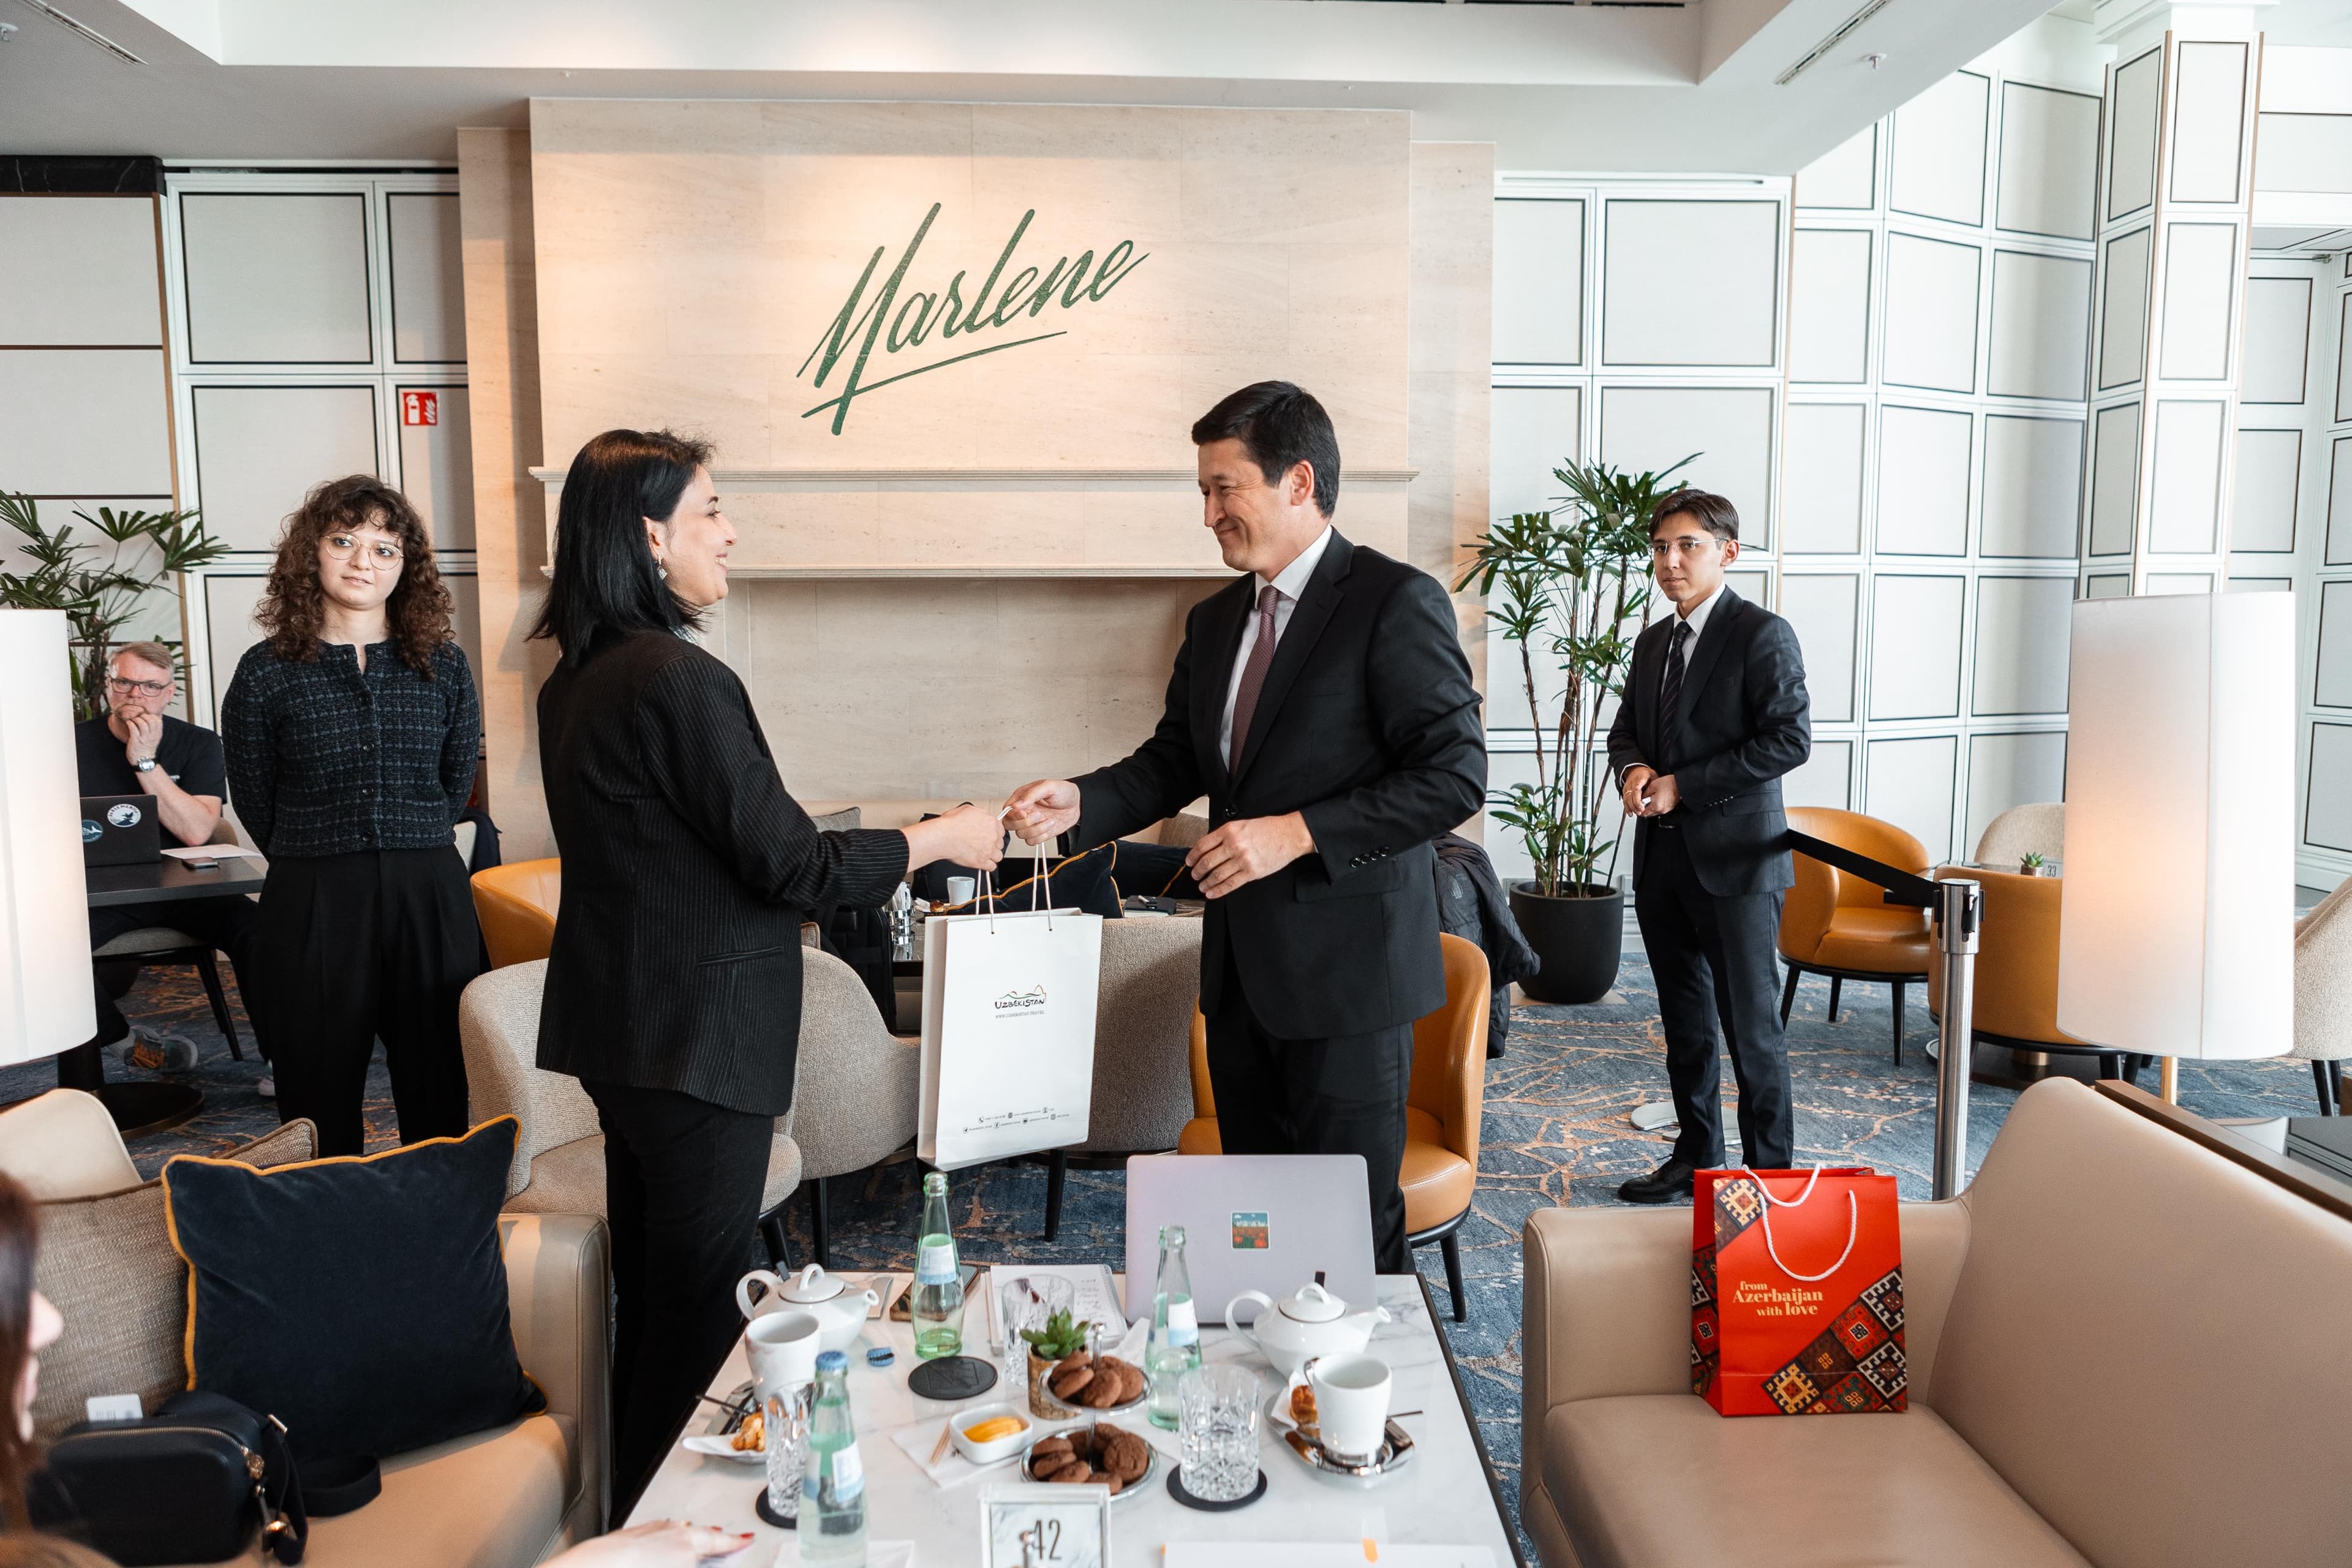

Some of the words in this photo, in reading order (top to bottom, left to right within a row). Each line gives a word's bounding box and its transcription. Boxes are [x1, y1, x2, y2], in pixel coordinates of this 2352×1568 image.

[796, 202, 1150, 435] Marlene
[2047, 865, 2057, 877] 33
[995, 999, 1045, 1009] UZBEKISTAN
[1740, 1281, 1768, 1291] from
[1732, 1288, 1823, 1305] Azerbaijan
[1756, 1306, 1783, 1316] with
[1785, 1302, 1819, 1316] love
